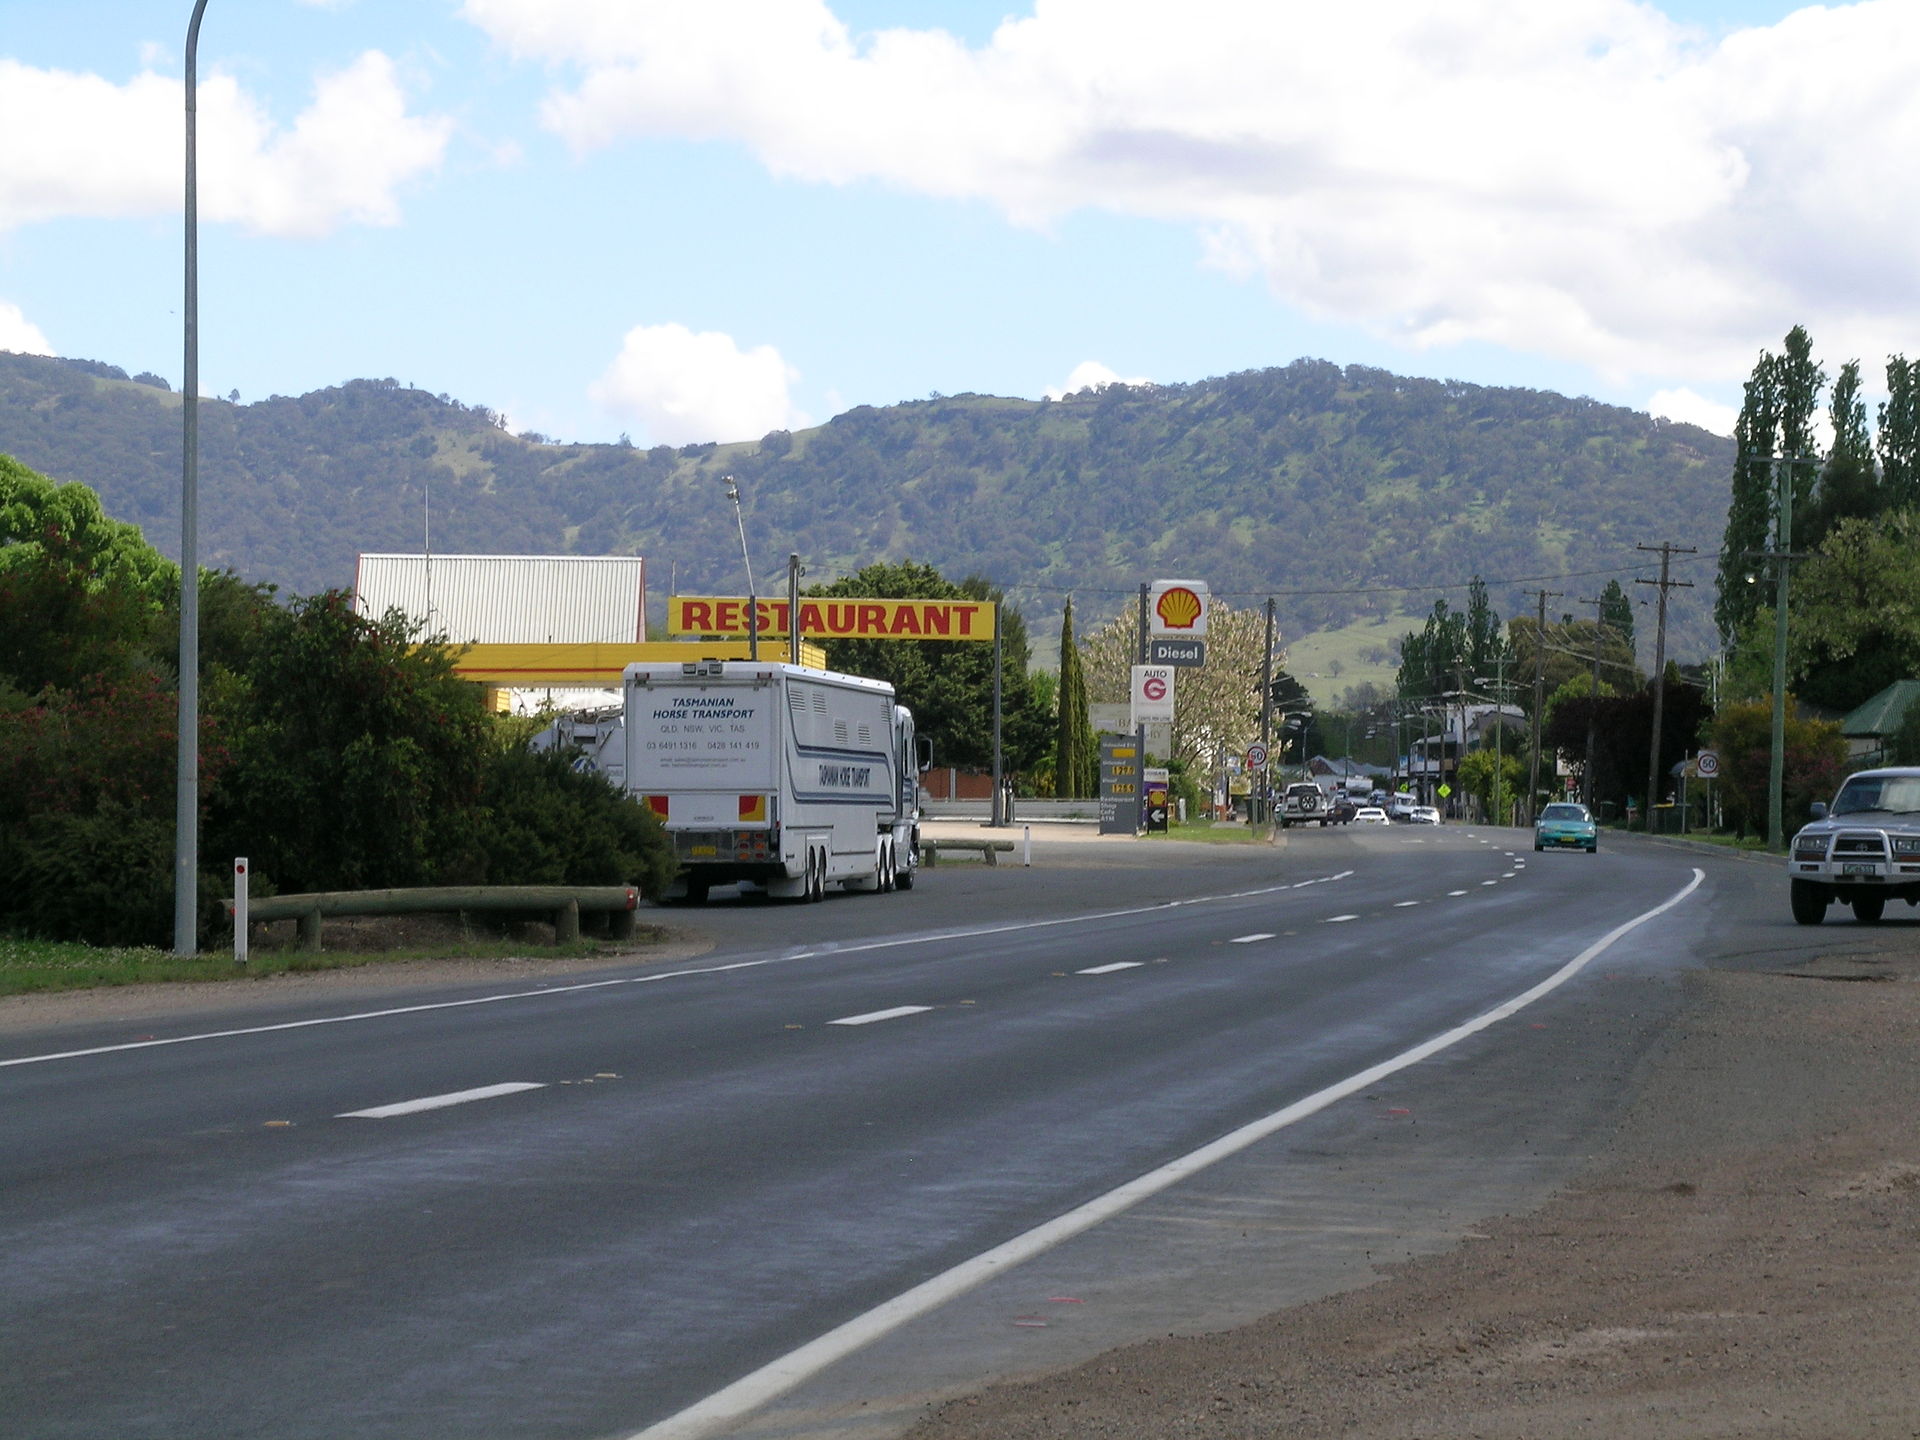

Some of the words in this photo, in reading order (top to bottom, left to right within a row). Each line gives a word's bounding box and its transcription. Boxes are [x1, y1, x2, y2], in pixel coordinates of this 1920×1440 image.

[681, 602, 979, 635] RESTAURANT
[1158, 646, 1198, 660] Diesel
[1143, 670, 1168, 678] AUTO
[672, 698, 735, 707] TASMANIAN
[653, 710, 688, 719] HORSE
[692, 709, 755, 719] TRANSPORT
[646, 742, 656, 750] 03
[1702, 758, 1715, 768] 50
